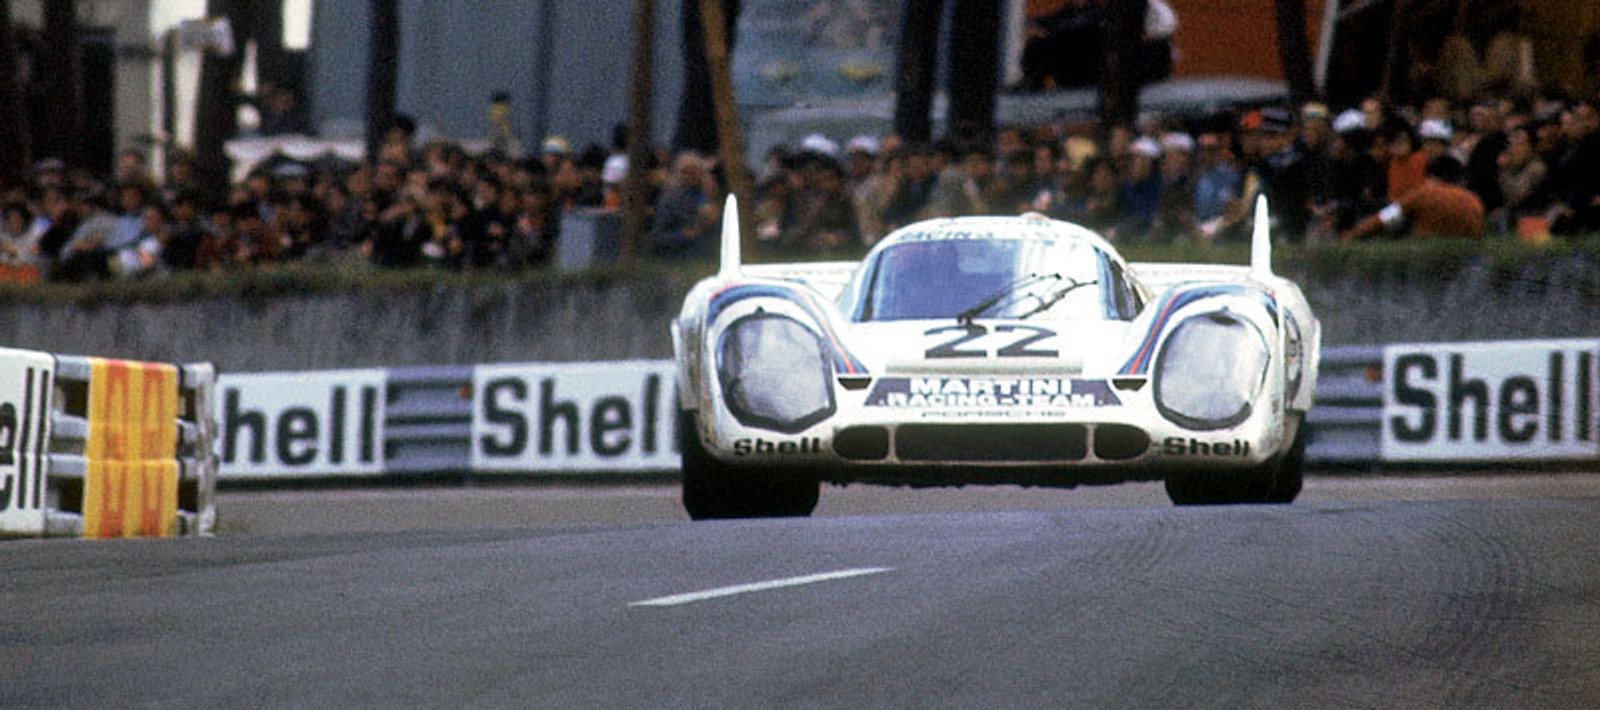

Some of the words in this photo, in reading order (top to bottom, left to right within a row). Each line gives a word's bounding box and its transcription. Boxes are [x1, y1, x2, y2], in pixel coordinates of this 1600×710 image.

[923, 325, 1059, 359] 22
[909, 378, 1072, 394] MARTINI
[1391, 351, 1592, 442] Shell
[214, 385, 378, 465] hell
[734, 437, 820, 455] Shell
[1163, 437, 1250, 456] Shell
